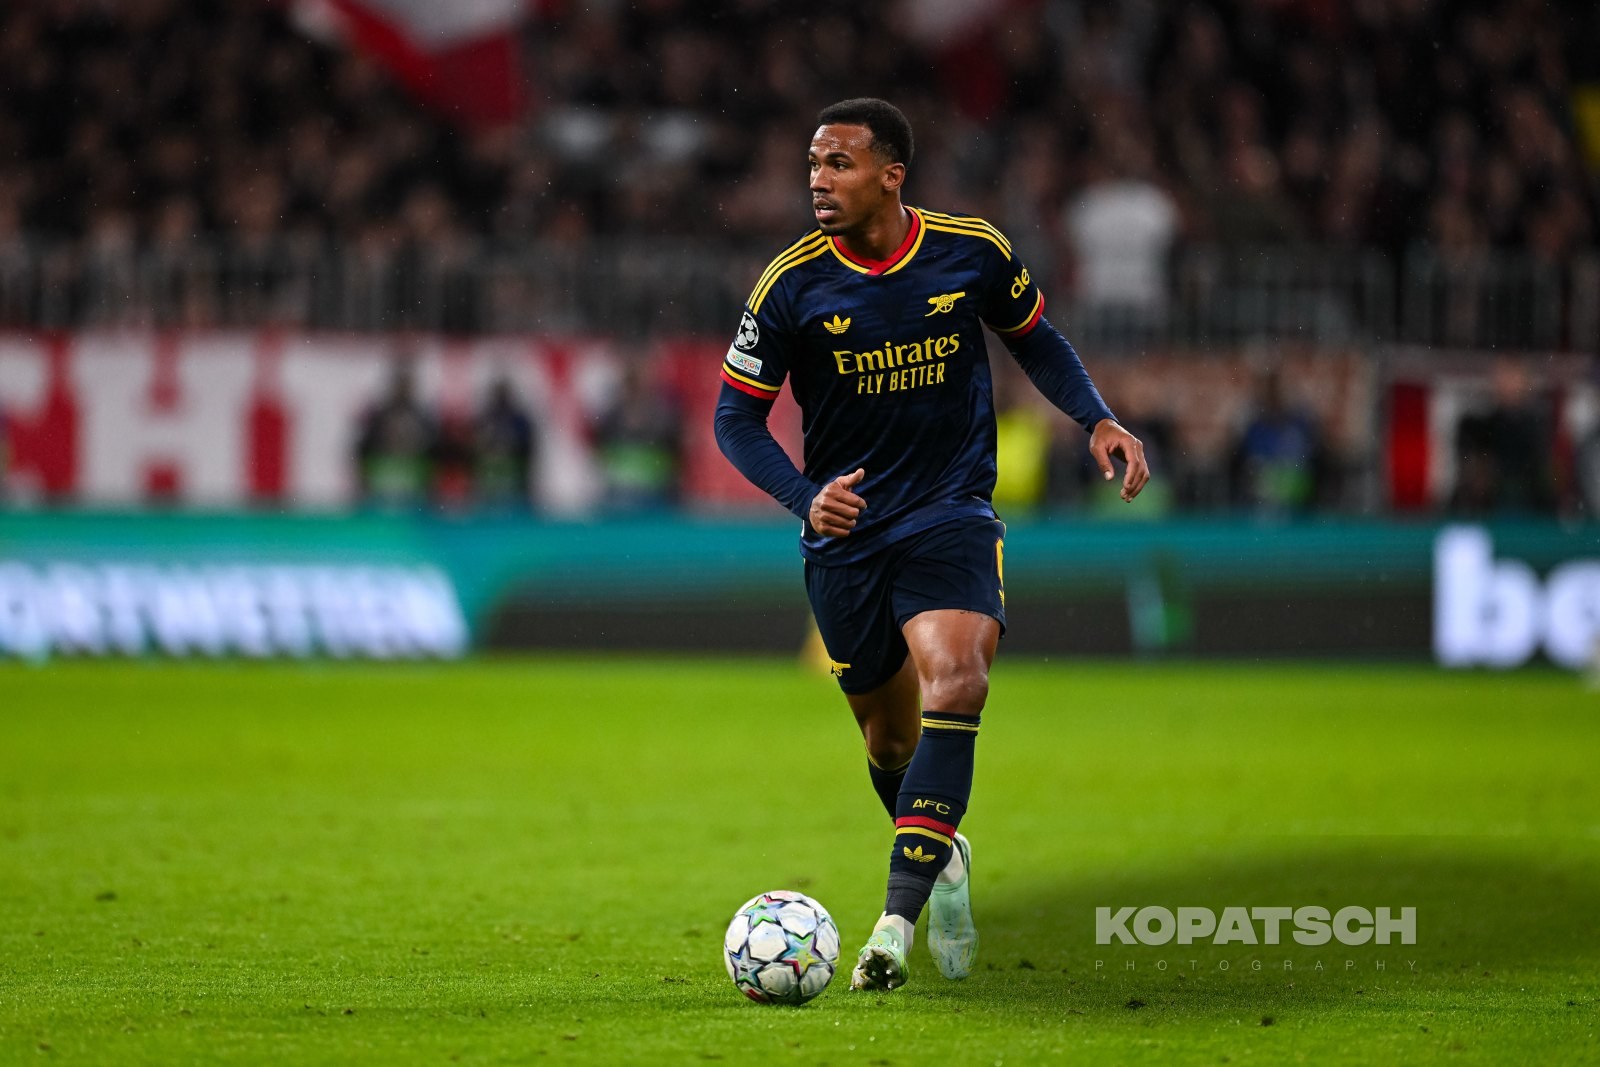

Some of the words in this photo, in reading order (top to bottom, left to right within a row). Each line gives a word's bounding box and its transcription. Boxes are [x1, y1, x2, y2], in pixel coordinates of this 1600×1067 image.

[832, 333, 960, 375] Emirates
[857, 373, 884, 395] FLY
[889, 362, 945, 392] BETTER
[912, 798, 950, 815] AFC
